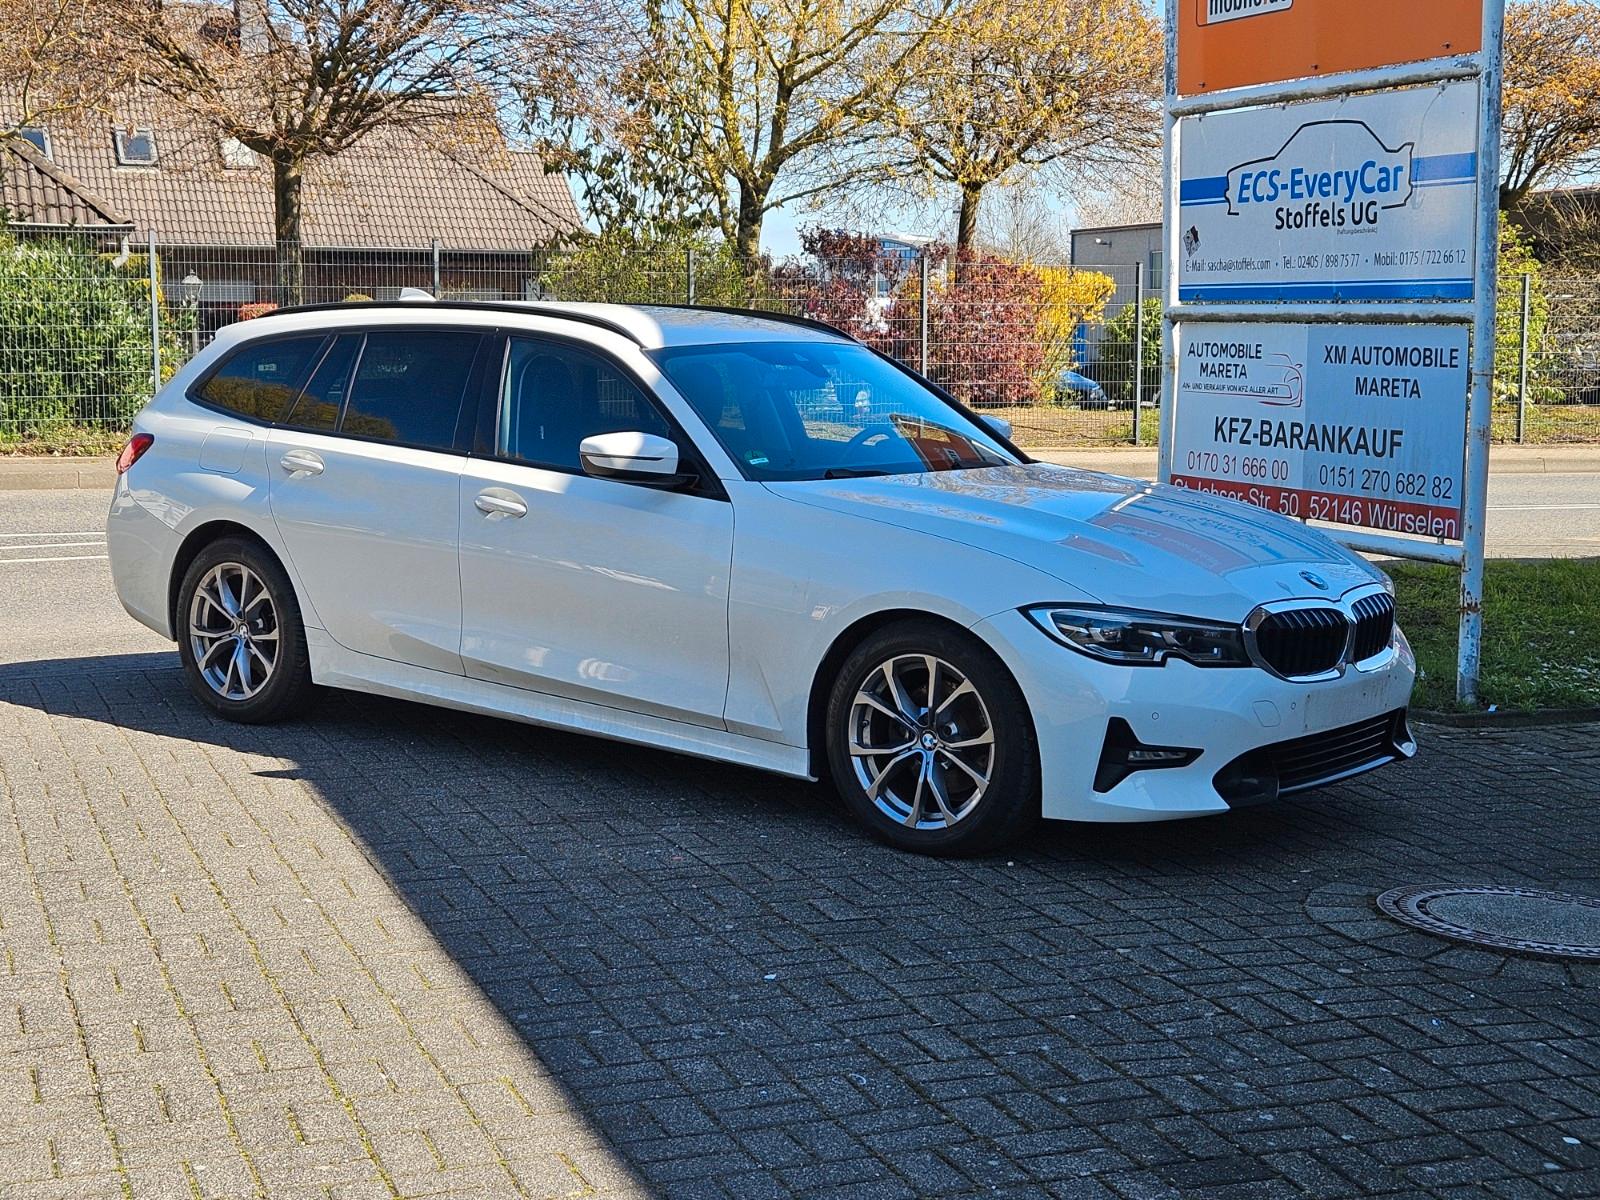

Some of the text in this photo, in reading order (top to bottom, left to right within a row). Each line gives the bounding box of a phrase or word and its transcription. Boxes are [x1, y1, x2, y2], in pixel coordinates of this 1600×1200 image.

[1238, 160, 1404, 203] ECS-EveryCar
[1275, 201, 1378, 230] Stoffels UG
[1185, 259, 1206, 273] E-Mail:
[1207, 257, 1271, 273] sascha@stoffels.com
[1283, 255, 1296, 269] Tel.:
[1298, 255, 1318, 269] 02405
[1325, 254, 1339, 268] 898
[1340, 254, 1349, 267] 75
[1350, 253, 1360, 267] 77
[1374, 251, 1398, 266] Mobil:
[1400, 250, 1418, 265] 0175
[1426, 250, 1441, 265] 722
[1443, 249, 1454, 264] 66
[1456, 249, 1466, 264] 12
[1187, 342, 1262, 360] AUTOMOBILE
[1324, 345, 1459, 368] XM AUTOMOBILE
[1199, 362, 1248, 379] MARETA
[1192, 382, 1202, 390] UND
[1204, 383, 1226, 391] VERKAUF
[1227, 384, 1237, 392] VON
[1238, 385, 1248, 393] KFZ
[1249, 386, 1266, 394] ALLER
[1267, 387, 1279, 395] ART
[1355, 376, 1421, 399] MARETA
[1214, 416, 1404, 459] KFZ-BARANKAUF
[1187, 450, 1289, 481] 0170 31 666 00
[1319, 464, 1453, 500] 0151 270 682 82
[1279, 492, 1299, 516] 50
[1309, 495, 1362, 525] 52146
[1368, 502, 1457, 538] Würselen
